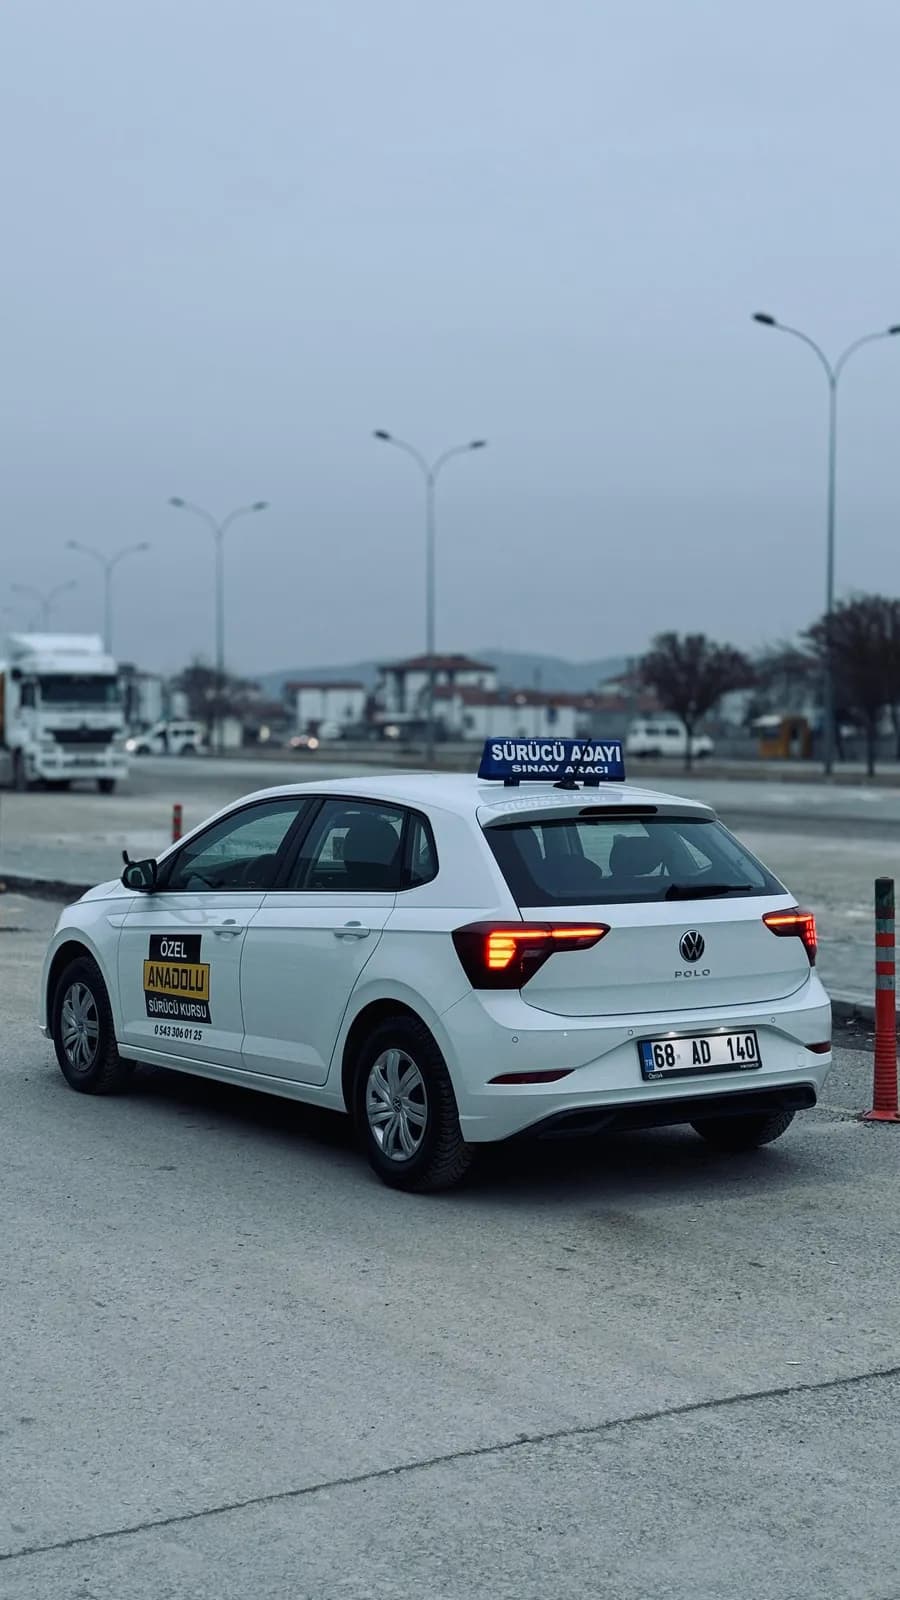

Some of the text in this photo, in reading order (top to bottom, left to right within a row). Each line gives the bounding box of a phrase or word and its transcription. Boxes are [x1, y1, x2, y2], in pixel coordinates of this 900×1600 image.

[491, 741, 621, 762] SÜRÜCÜ ADAYI
[511, 764, 609, 774] SINAV ARACI
[160, 937, 187, 958] ÖZEL
[148, 966, 204, 992] ANADOLU
[674, 969, 711, 978] POLO
[148, 997, 207, 1018] SÜRÜCÜ KURSU
[155, 1025, 202, 1040] 0 543 306 01 25
[644, 1058, 654, 1067] TR
[653, 1036, 755, 1068] 68 AD 140
